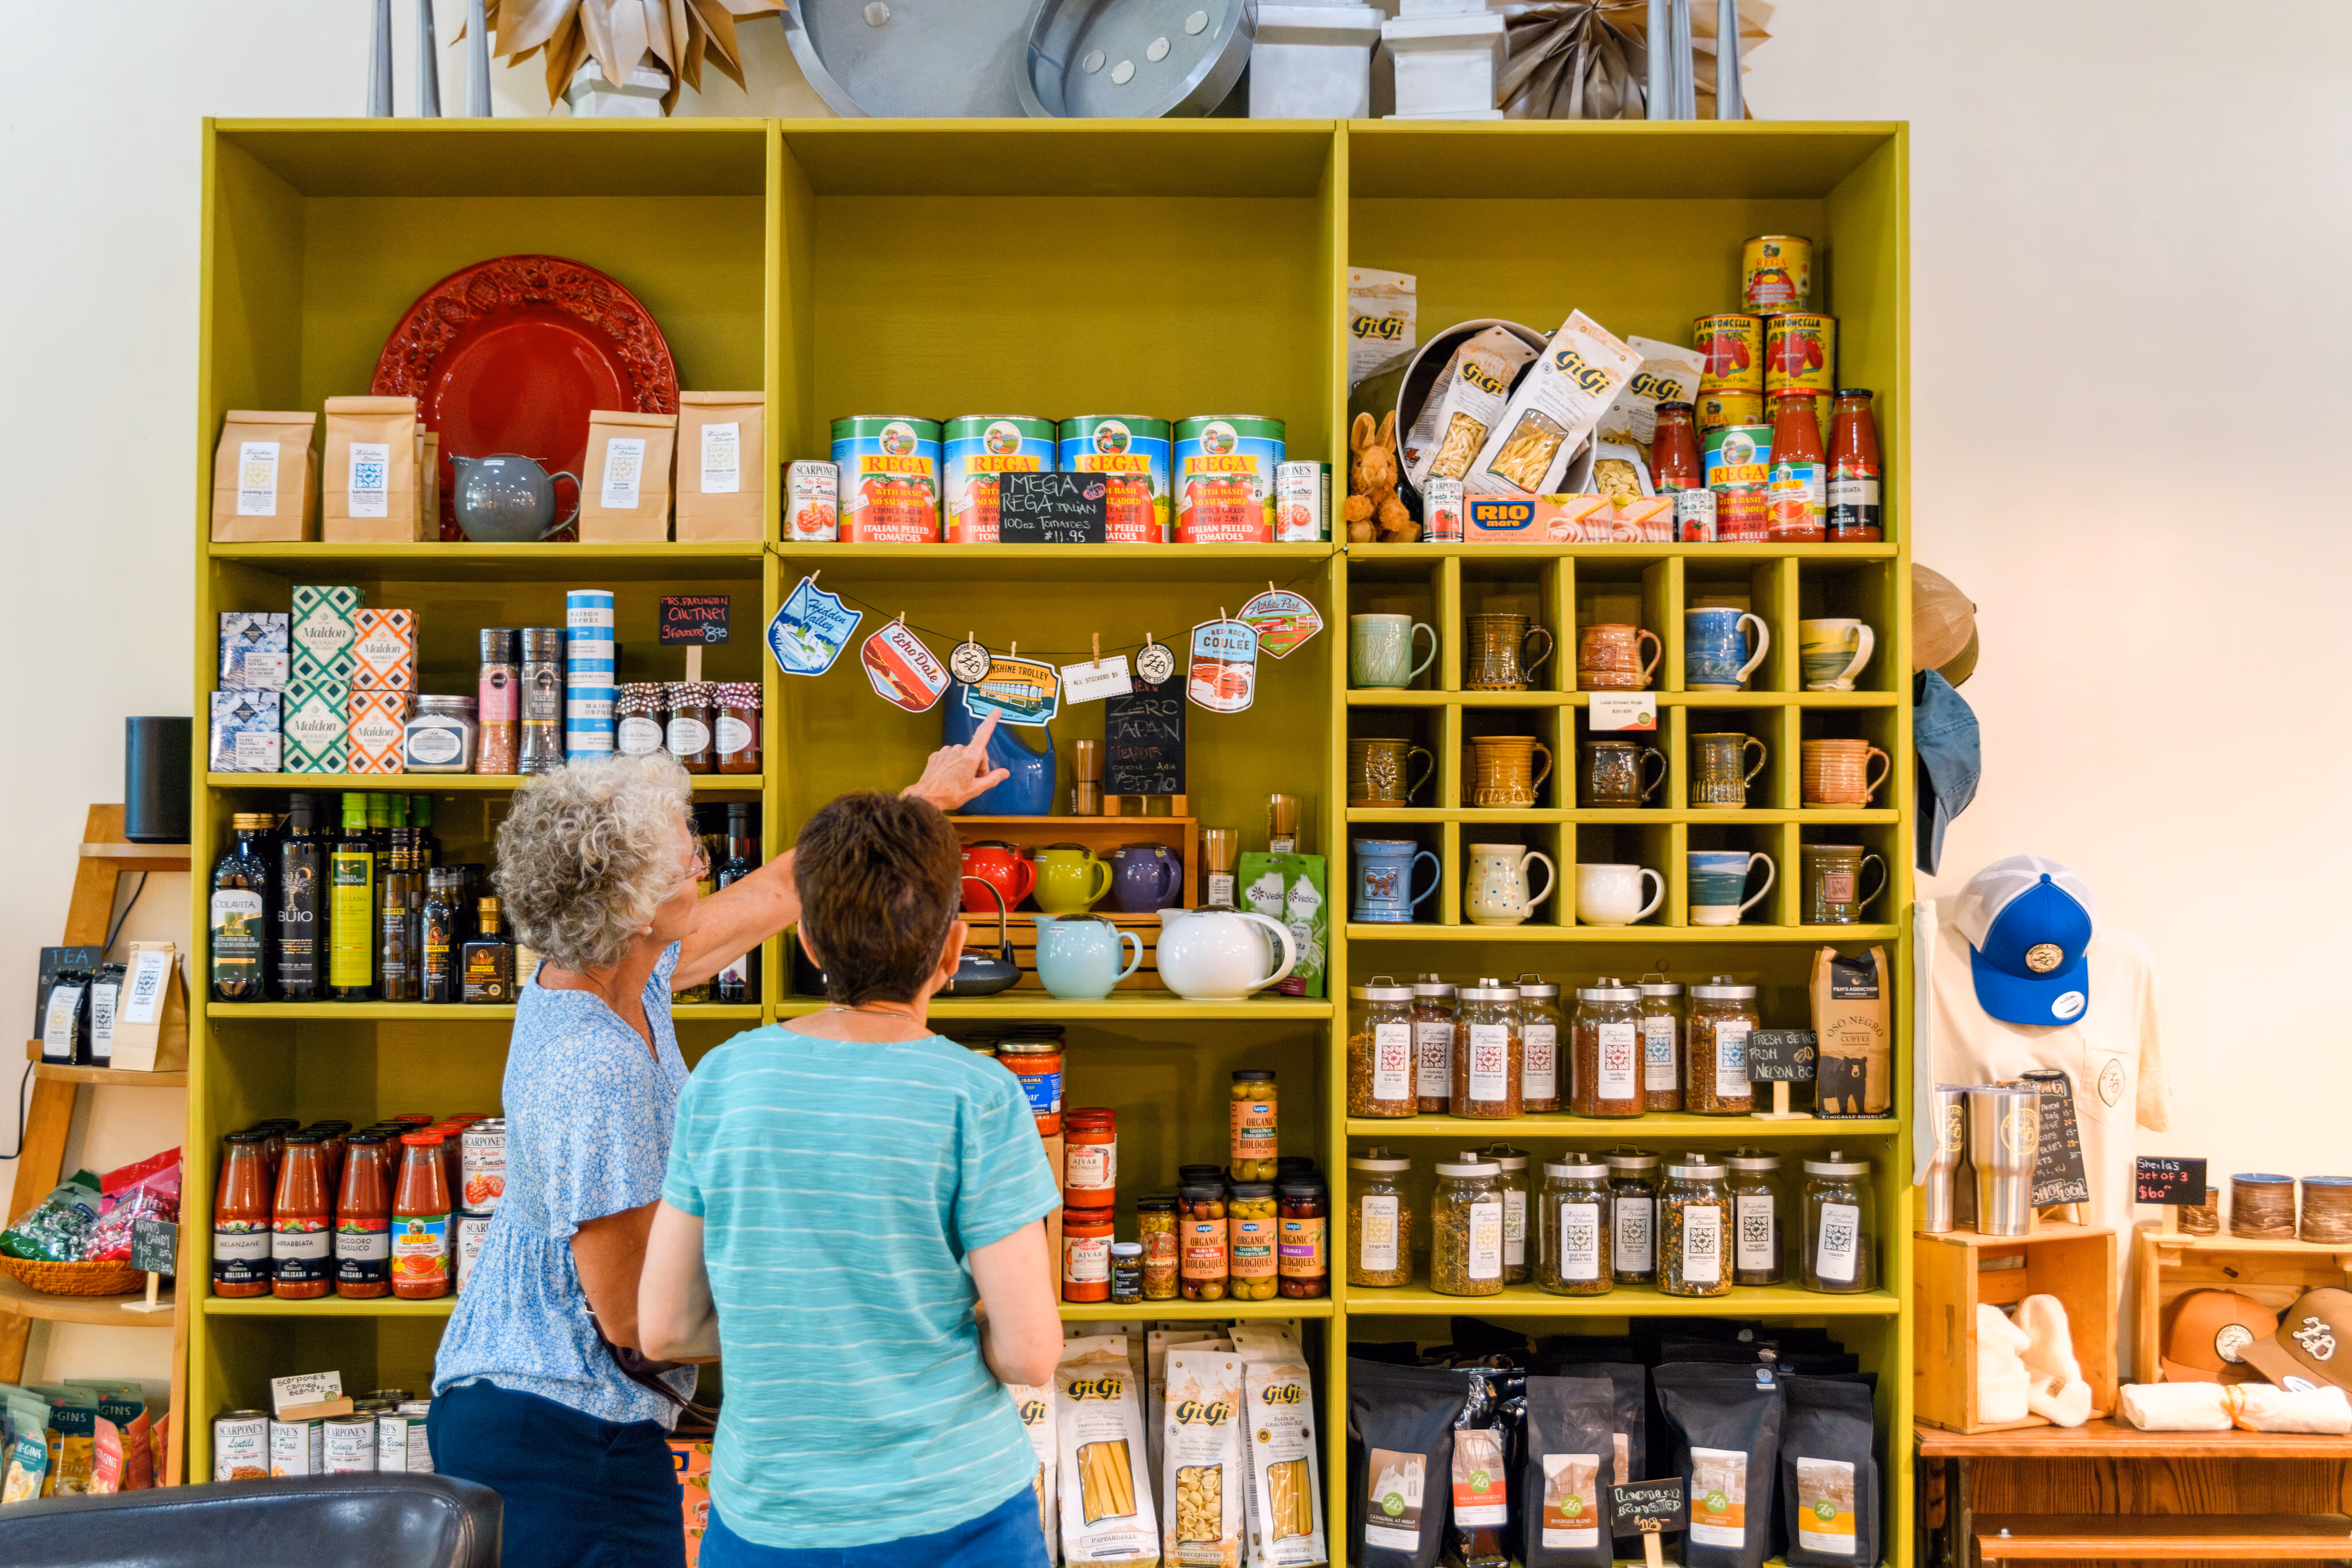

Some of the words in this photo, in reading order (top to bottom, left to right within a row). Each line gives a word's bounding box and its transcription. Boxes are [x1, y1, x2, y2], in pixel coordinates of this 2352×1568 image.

[1351, 316, 1404, 340] GiGi
[1703, 318, 1751, 330] PAVONCELLA
[1773, 317, 1820, 331] PAVONCELLA
[1462, 361, 1505, 394] GiGi
[1553, 349, 1611, 395] GiGi
[1628, 373, 1683, 402] GiGi
[869, 457, 925, 473] REGA
[974, 457, 1031, 472] REGA
[1084, 455, 1141, 472] REGA
[1191, 457, 1249, 472] REGA
[1714, 466, 1768, 482] REGA
[1010, 475, 1078, 496] MEGA
[1001, 493, 1053, 513] REGA
[1117, 497, 1141, 505] ADDED
[1738, 496, 1761, 504] BASIL
[1477, 505, 1529, 519] RIO
[863, 525, 898, 533] ITALIAN
[901, 526, 929, 534] PEELED
[1188, 525, 1218, 534] ITALIAN
[1221, 525, 1253, 533] PEELED
[873, 533, 921, 542] TOMATOES
[1044, 530, 1085, 542] $11.95
[1196, 533, 1243, 541] TOMATOES
[808, 598, 847, 625] Hidden
[1249, 600, 1280, 614] Athletic
[1281, 597, 1301, 612] Park
[303, 627, 346, 638] Maldon
[662, 625, 670, 639] 3
[1228, 629, 1246, 638] ROCK
[364, 644, 401, 654] Maldon
[1203, 636, 1250, 650] COULEE
[892, 633, 917, 657] Echo
[913, 653, 938, 683] Dale
[1018, 667, 1049, 680] TROLLEY
[1086, 674, 1109, 684] STICKERS
[1110, 696, 1179, 717] ZERO
[293, 721, 337, 731] Maldon
[358, 727, 394, 737] Maldon
[1108, 717, 1180, 742] JAPAN
[215, 899, 257, 909] COLAVITA
[278, 911, 313, 922] BUIO
[51, 949, 88, 965] TEA
[1827, 1019, 1846, 1038] OSO
[1850, 1016, 1883, 1037] NEGRO
[1753, 1033, 1782, 1046] FRESH
[1749, 1049, 1777, 1060] FROM
[1798, 1065, 1814, 1078] BC
[1246, 1117, 1273, 1126] ORGANIC
[2137, 1158, 2179, 1171] Sheila's
[2138, 1170, 2158, 1179] Set
[2180, 1172, 2188, 1181] 3
[147, 1233, 170, 1248] CANDY
[1191, 1236, 1219, 1246] ORGANIC
[1237, 1235, 1266, 1244] ORGANIC
[1281, 1234, 1308, 1244] ORGANIC
[1185, 1257, 1226, 1268] BIOLOGIQUES
[1066, 1377, 1123, 1402] GiGi
[1262, 1384, 1301, 1406] GiGi
[1175, 1400, 1230, 1428] GiGi
[219, 1425, 264, 1435] SCARPONE'S
[326, 1426, 367, 1436] SCARPONE'S
[227, 1439, 254, 1448] Lentils
[280, 1442, 296, 1450] Peas
[330, 1441, 352, 1451] Kidney
[386, 1438, 405, 1447] Beans
[1092, 1534, 1137, 1543] PAPPARDELLE
